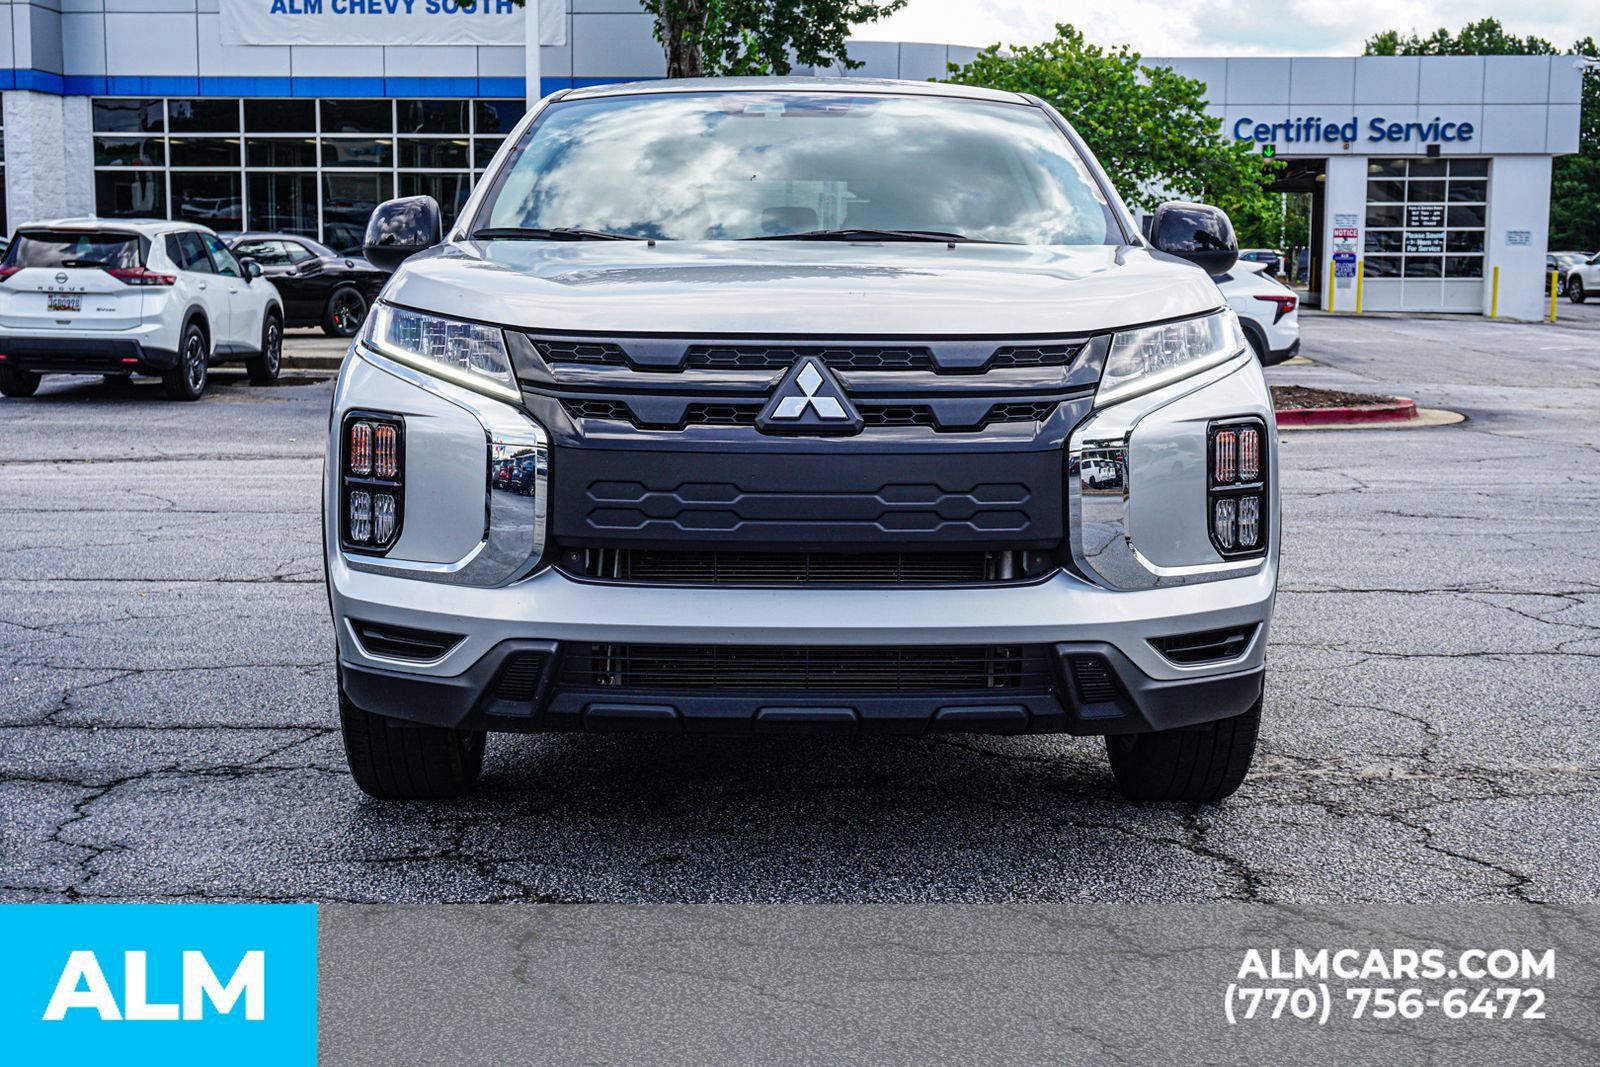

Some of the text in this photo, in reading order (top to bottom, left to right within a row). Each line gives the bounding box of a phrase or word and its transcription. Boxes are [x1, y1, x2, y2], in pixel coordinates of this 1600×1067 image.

[270, 0, 513, 15] ALM CHEVY SOUTH
[1234, 116, 1474, 143] Certified Service
[1334, 229, 1358, 237] NOTICE
